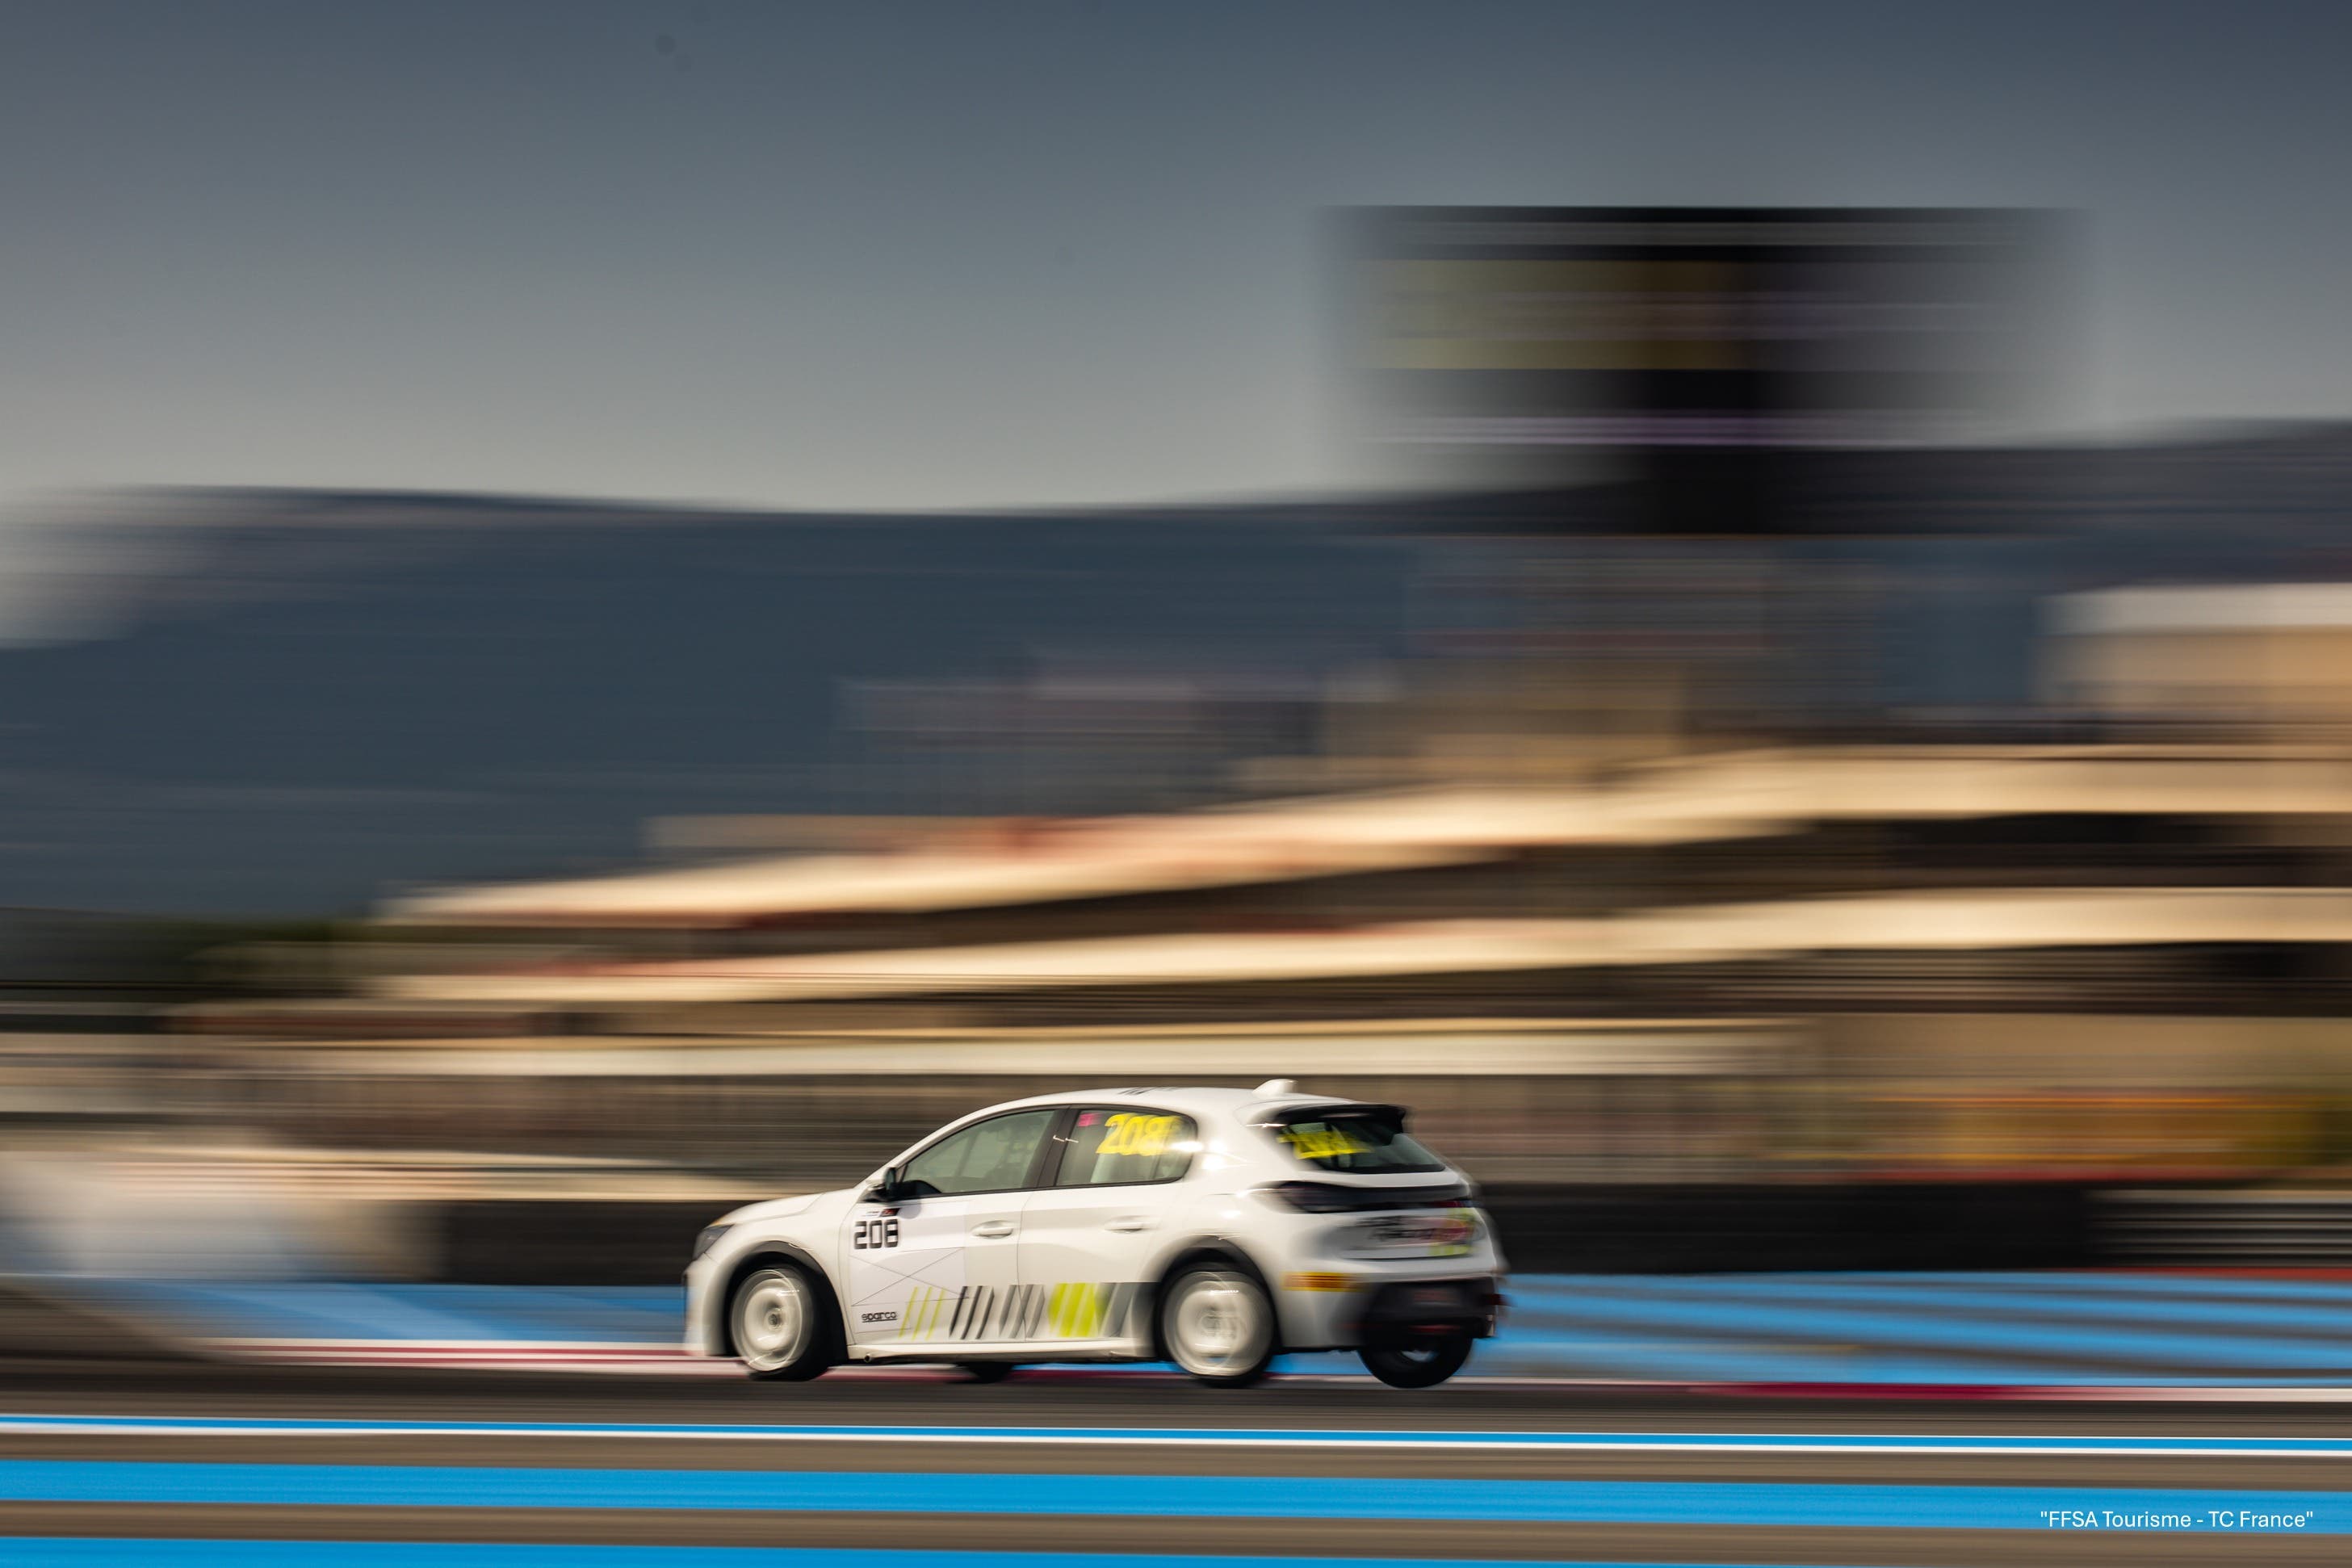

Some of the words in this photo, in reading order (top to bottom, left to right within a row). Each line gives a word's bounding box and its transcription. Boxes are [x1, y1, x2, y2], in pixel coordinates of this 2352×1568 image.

[1096, 1113, 1176, 1156] 208
[854, 1219, 898, 1250] 208
[862, 1312, 897, 1323] sparco
